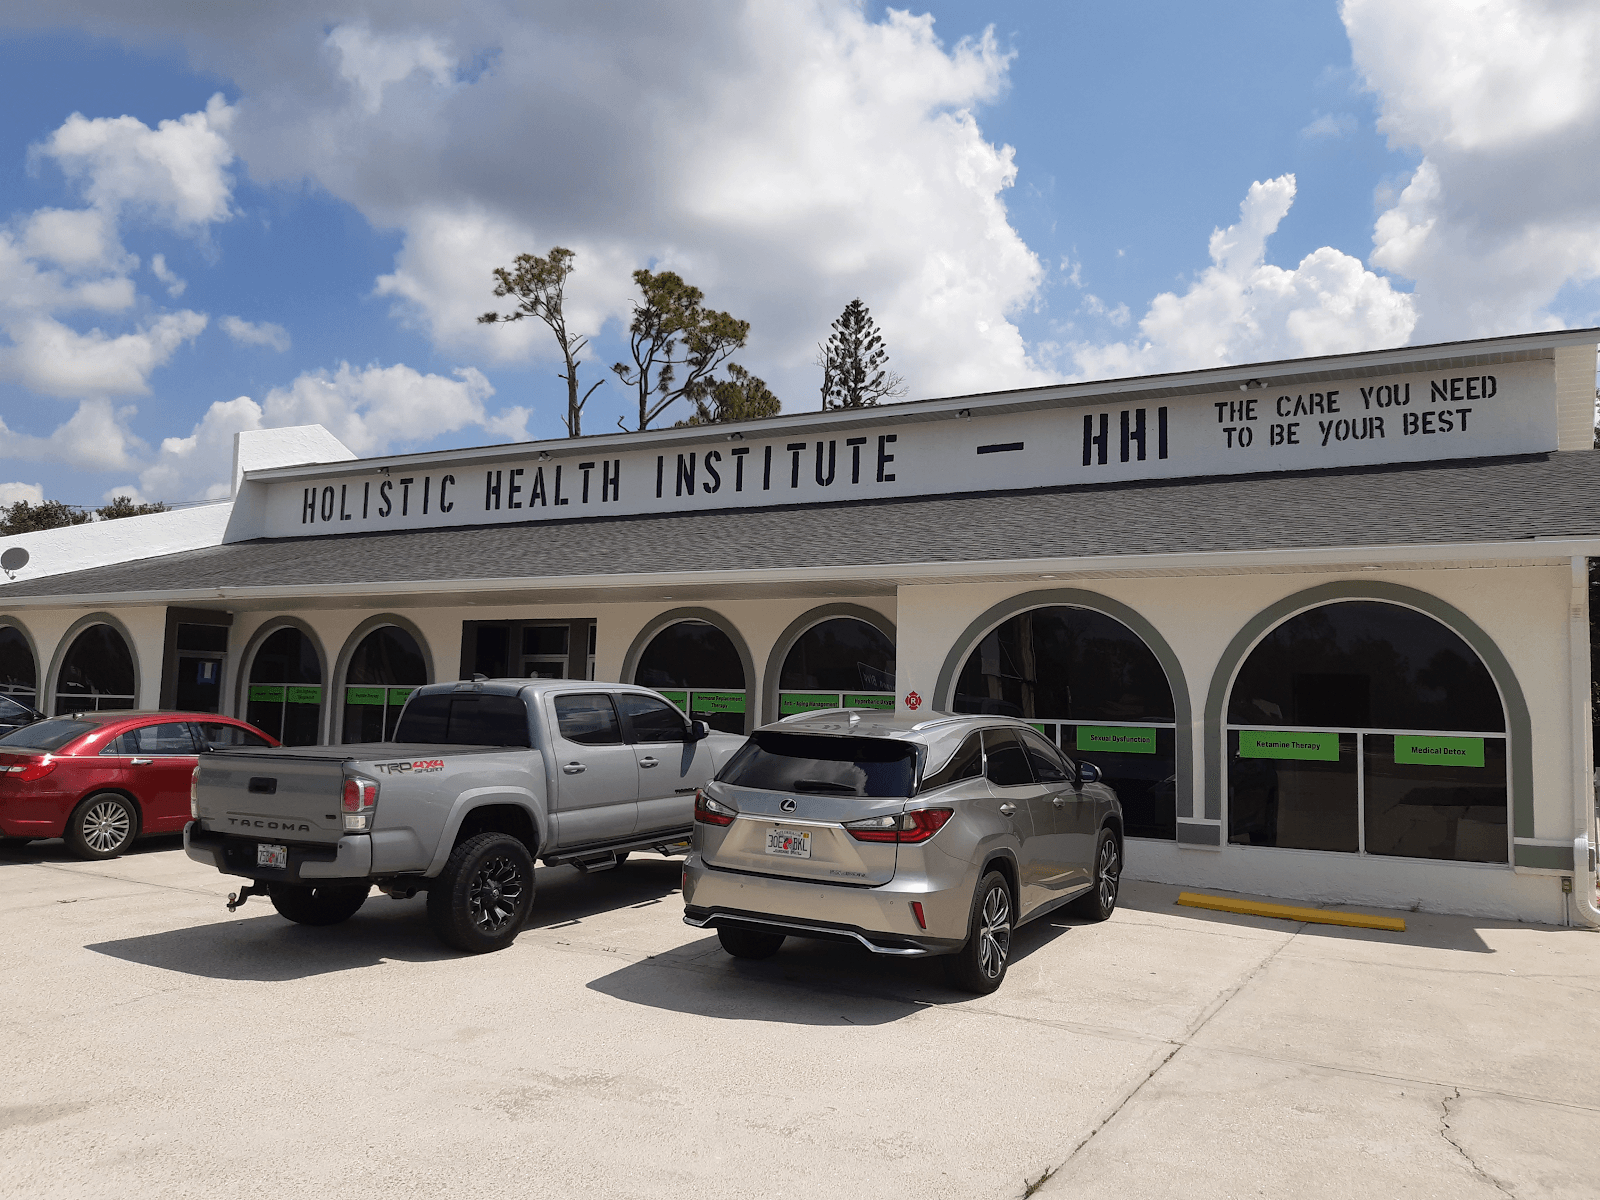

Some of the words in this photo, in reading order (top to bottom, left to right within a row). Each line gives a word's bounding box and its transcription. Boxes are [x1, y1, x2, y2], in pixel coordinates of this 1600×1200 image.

[1213, 399, 1259, 425] THE
[1276, 390, 1341, 418] CARE
[1360, 382, 1411, 410] YOU
[1431, 375, 1498, 403] NEED
[1223, 427, 1253, 449] TO
[1270, 423, 1300, 446] BE
[1318, 416, 1386, 447] YOUR
[1402, 407, 1473, 436] BEST
[303, 473, 456, 524] HOLISTIC
[486, 459, 621, 511] HEALTH
[655, 434, 897, 499] INSTITUTE
[1082, 407, 1169, 467] HHI
[1090, 734, 1111, 743] Sexual
[1112, 735, 1151, 745] Dysfunction
[1256, 739, 1290, 750] Ketamine
[1291, 740, 1321, 752] Therapy
[1411, 745, 1442, 755] Medical
[1443, 747, 1466, 757] Detox
[374, 762, 412, 775] TRD
[227, 818, 310, 832] TACOMA
